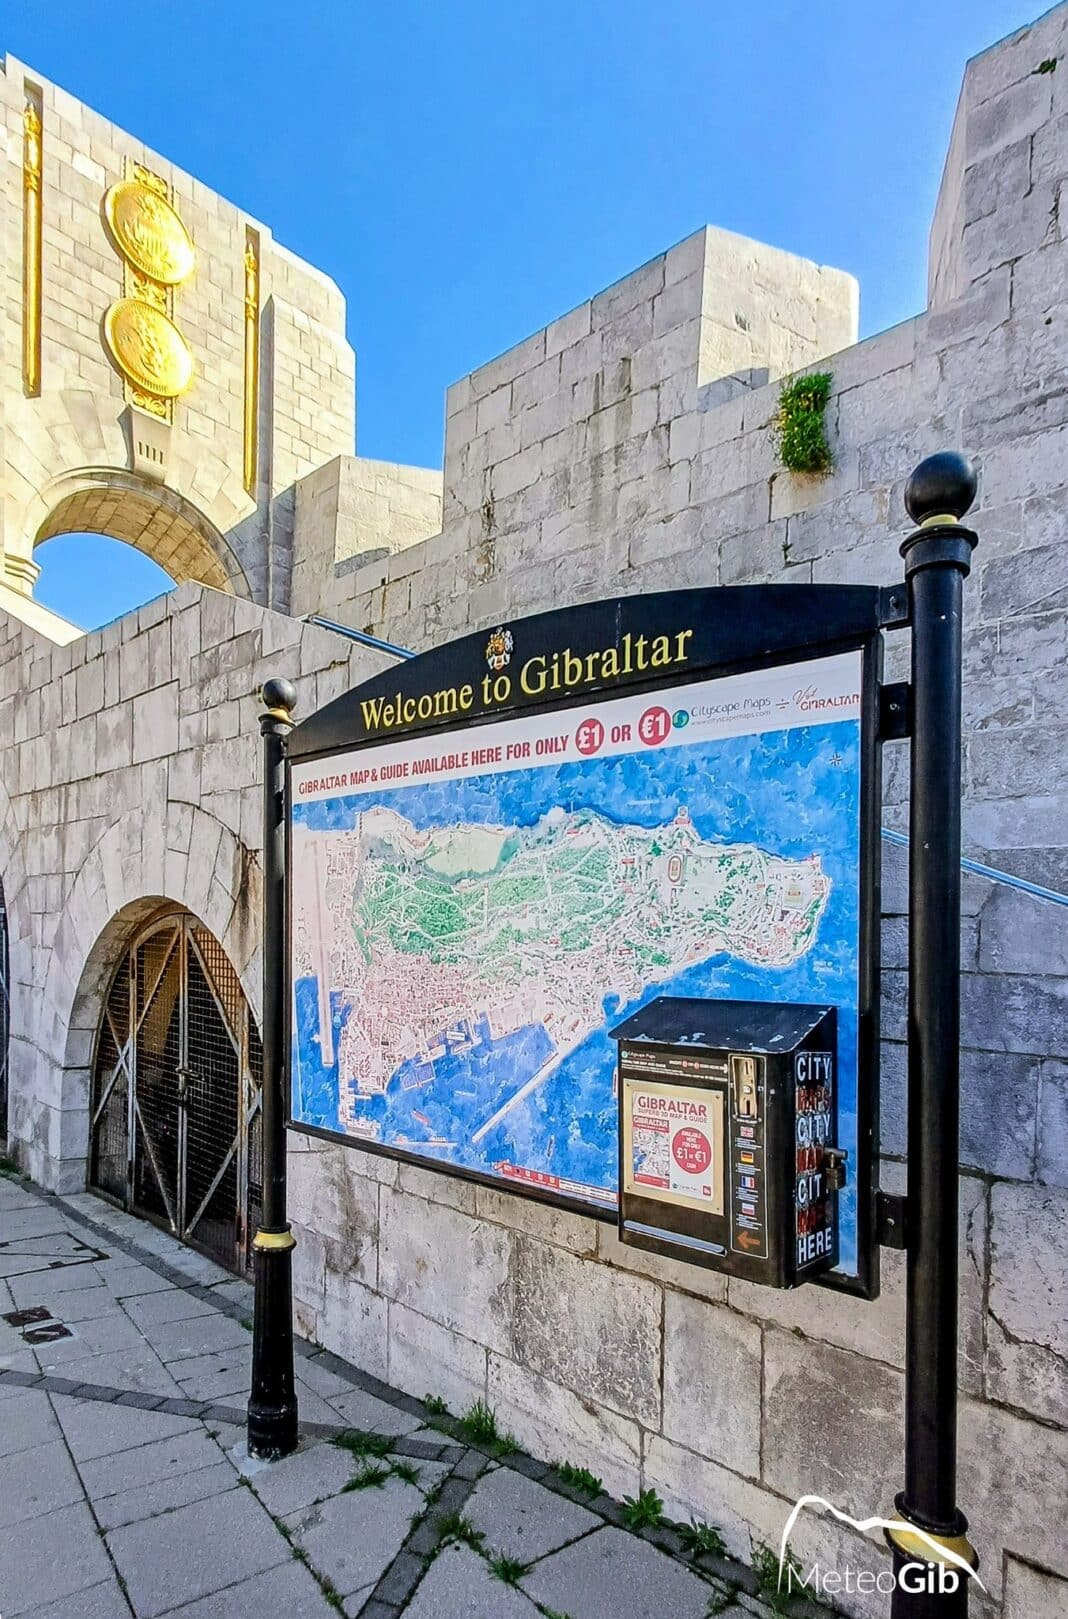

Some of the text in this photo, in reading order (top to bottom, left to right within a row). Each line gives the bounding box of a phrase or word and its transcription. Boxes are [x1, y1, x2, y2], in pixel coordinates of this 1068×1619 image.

[361, 629, 693, 731] Welcome to Gibraltar
[691, 697, 771, 718] Cityscape Maps
[298, 712, 666, 795] GIBRALTAR MAP & GUIDE AVAILABLE HERE FOR ONLY £1 OR €1
[797, 1057, 830, 1081] CITY
[638, 1096, 707, 1117] GIBRALTAR
[797, 1114, 830, 1142] CITY
[676, 1147, 688, 1159] £1
[798, 1173, 829, 1203] CIT
[798, 1226, 833, 1264] HERE
